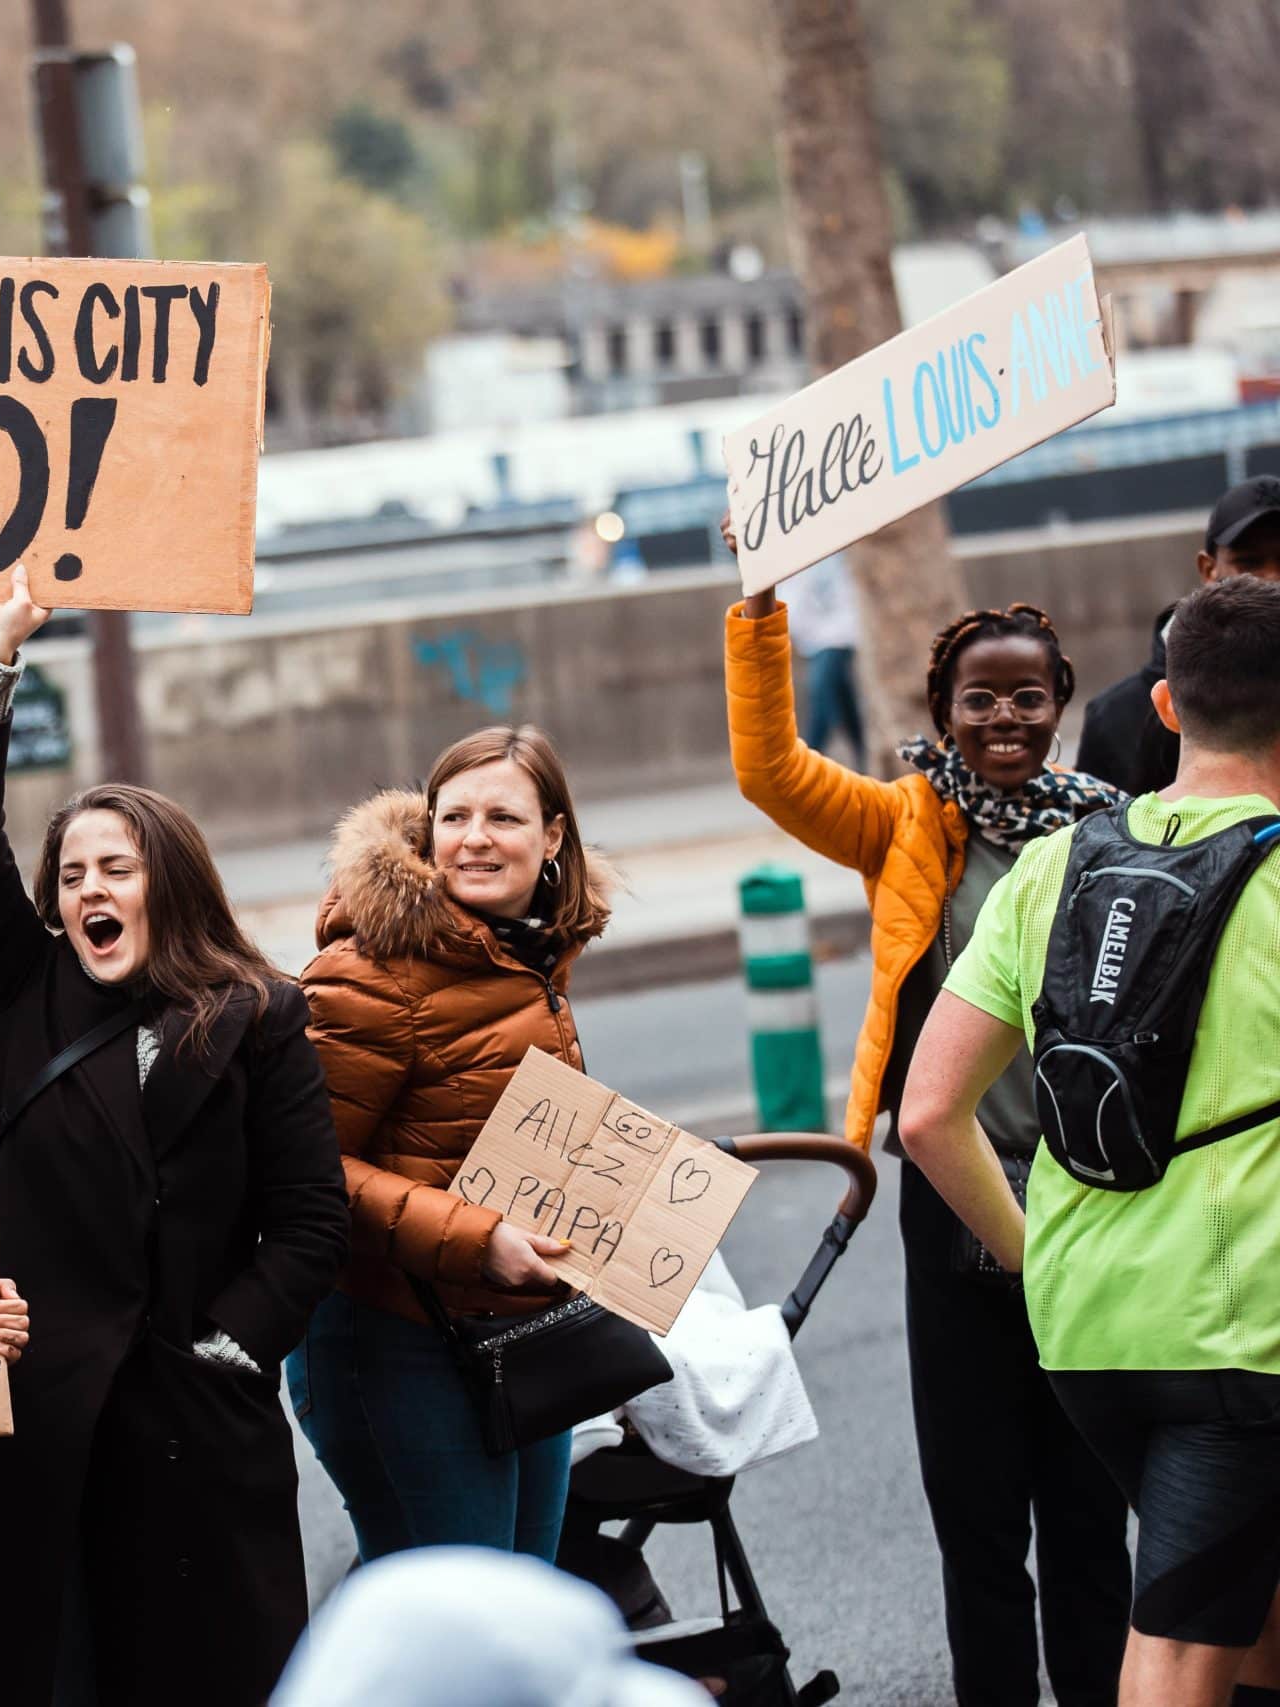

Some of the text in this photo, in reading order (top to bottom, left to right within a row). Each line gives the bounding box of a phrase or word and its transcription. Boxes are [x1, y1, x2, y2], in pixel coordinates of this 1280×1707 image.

[74, 282, 220, 387] CITY
[883, 333, 1000, 476] LOUIS
[1011, 271, 1101, 416] ANNE
[1089, 897, 1136, 1006] CAMELBAK
[507, 1175, 623, 1265] PAPA
